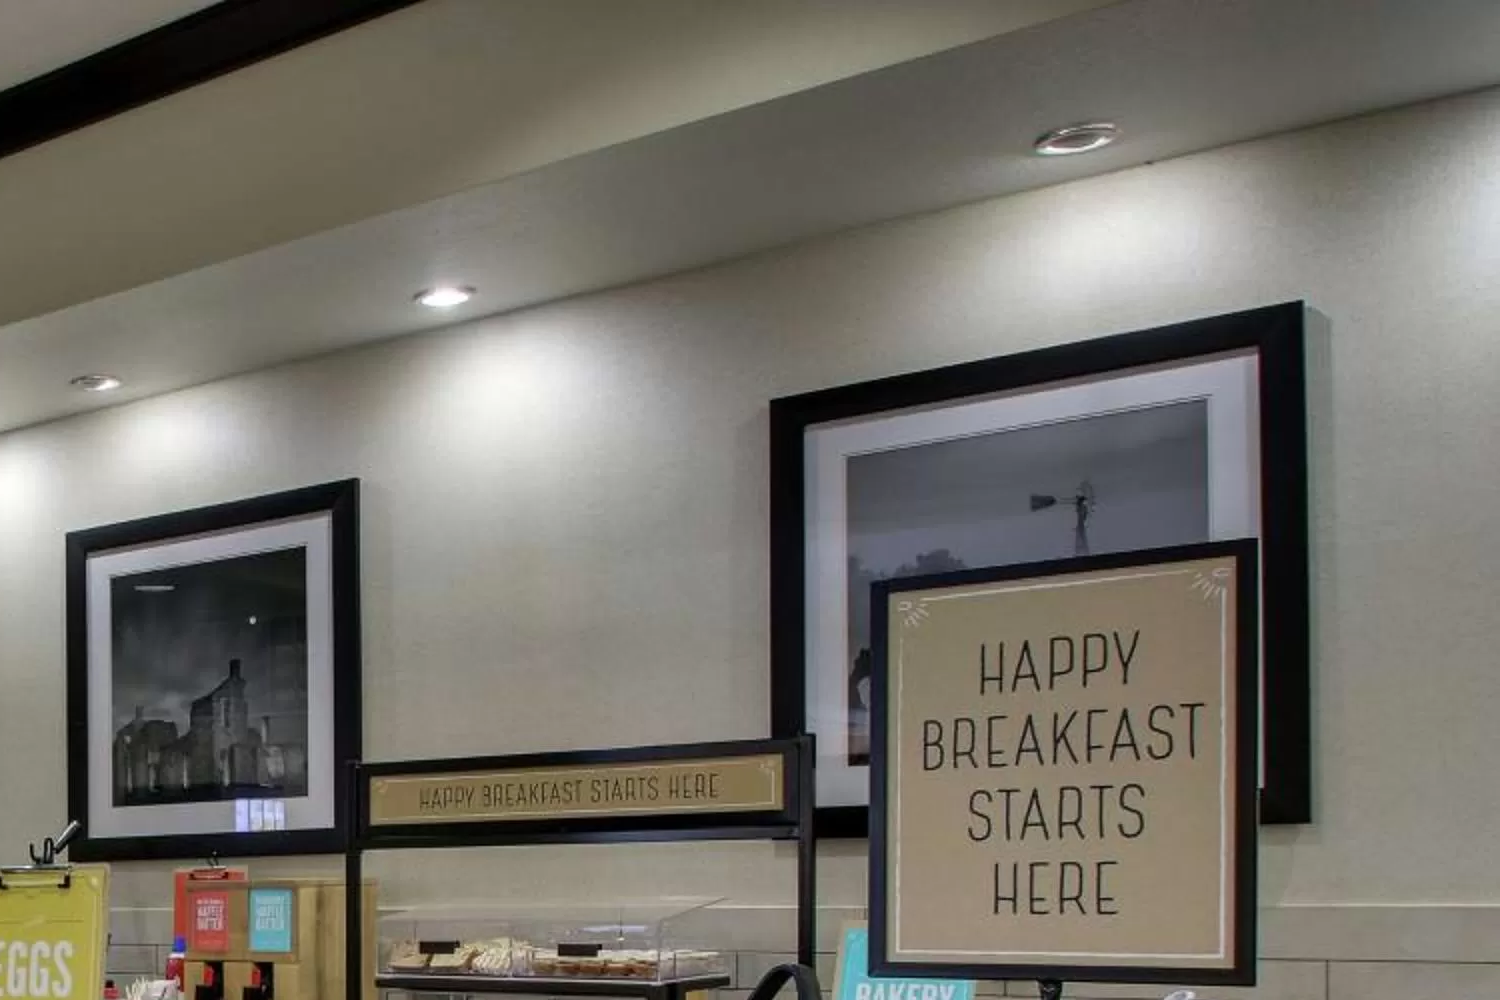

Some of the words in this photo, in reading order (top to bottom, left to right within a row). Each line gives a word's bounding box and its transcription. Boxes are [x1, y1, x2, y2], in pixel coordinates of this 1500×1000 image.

[980, 630, 1140, 695] HAPPY
[923, 703, 1205, 771] BREAKFAST
[419, 787, 474, 810] HAPPY
[483, 780, 583, 808] BREAKFAST
[590, 776, 659, 803] STARTS
[669, 772, 720, 799] HERE
[968, 784, 1145, 841] STARTS
[993, 862, 1118, 915] HERE
